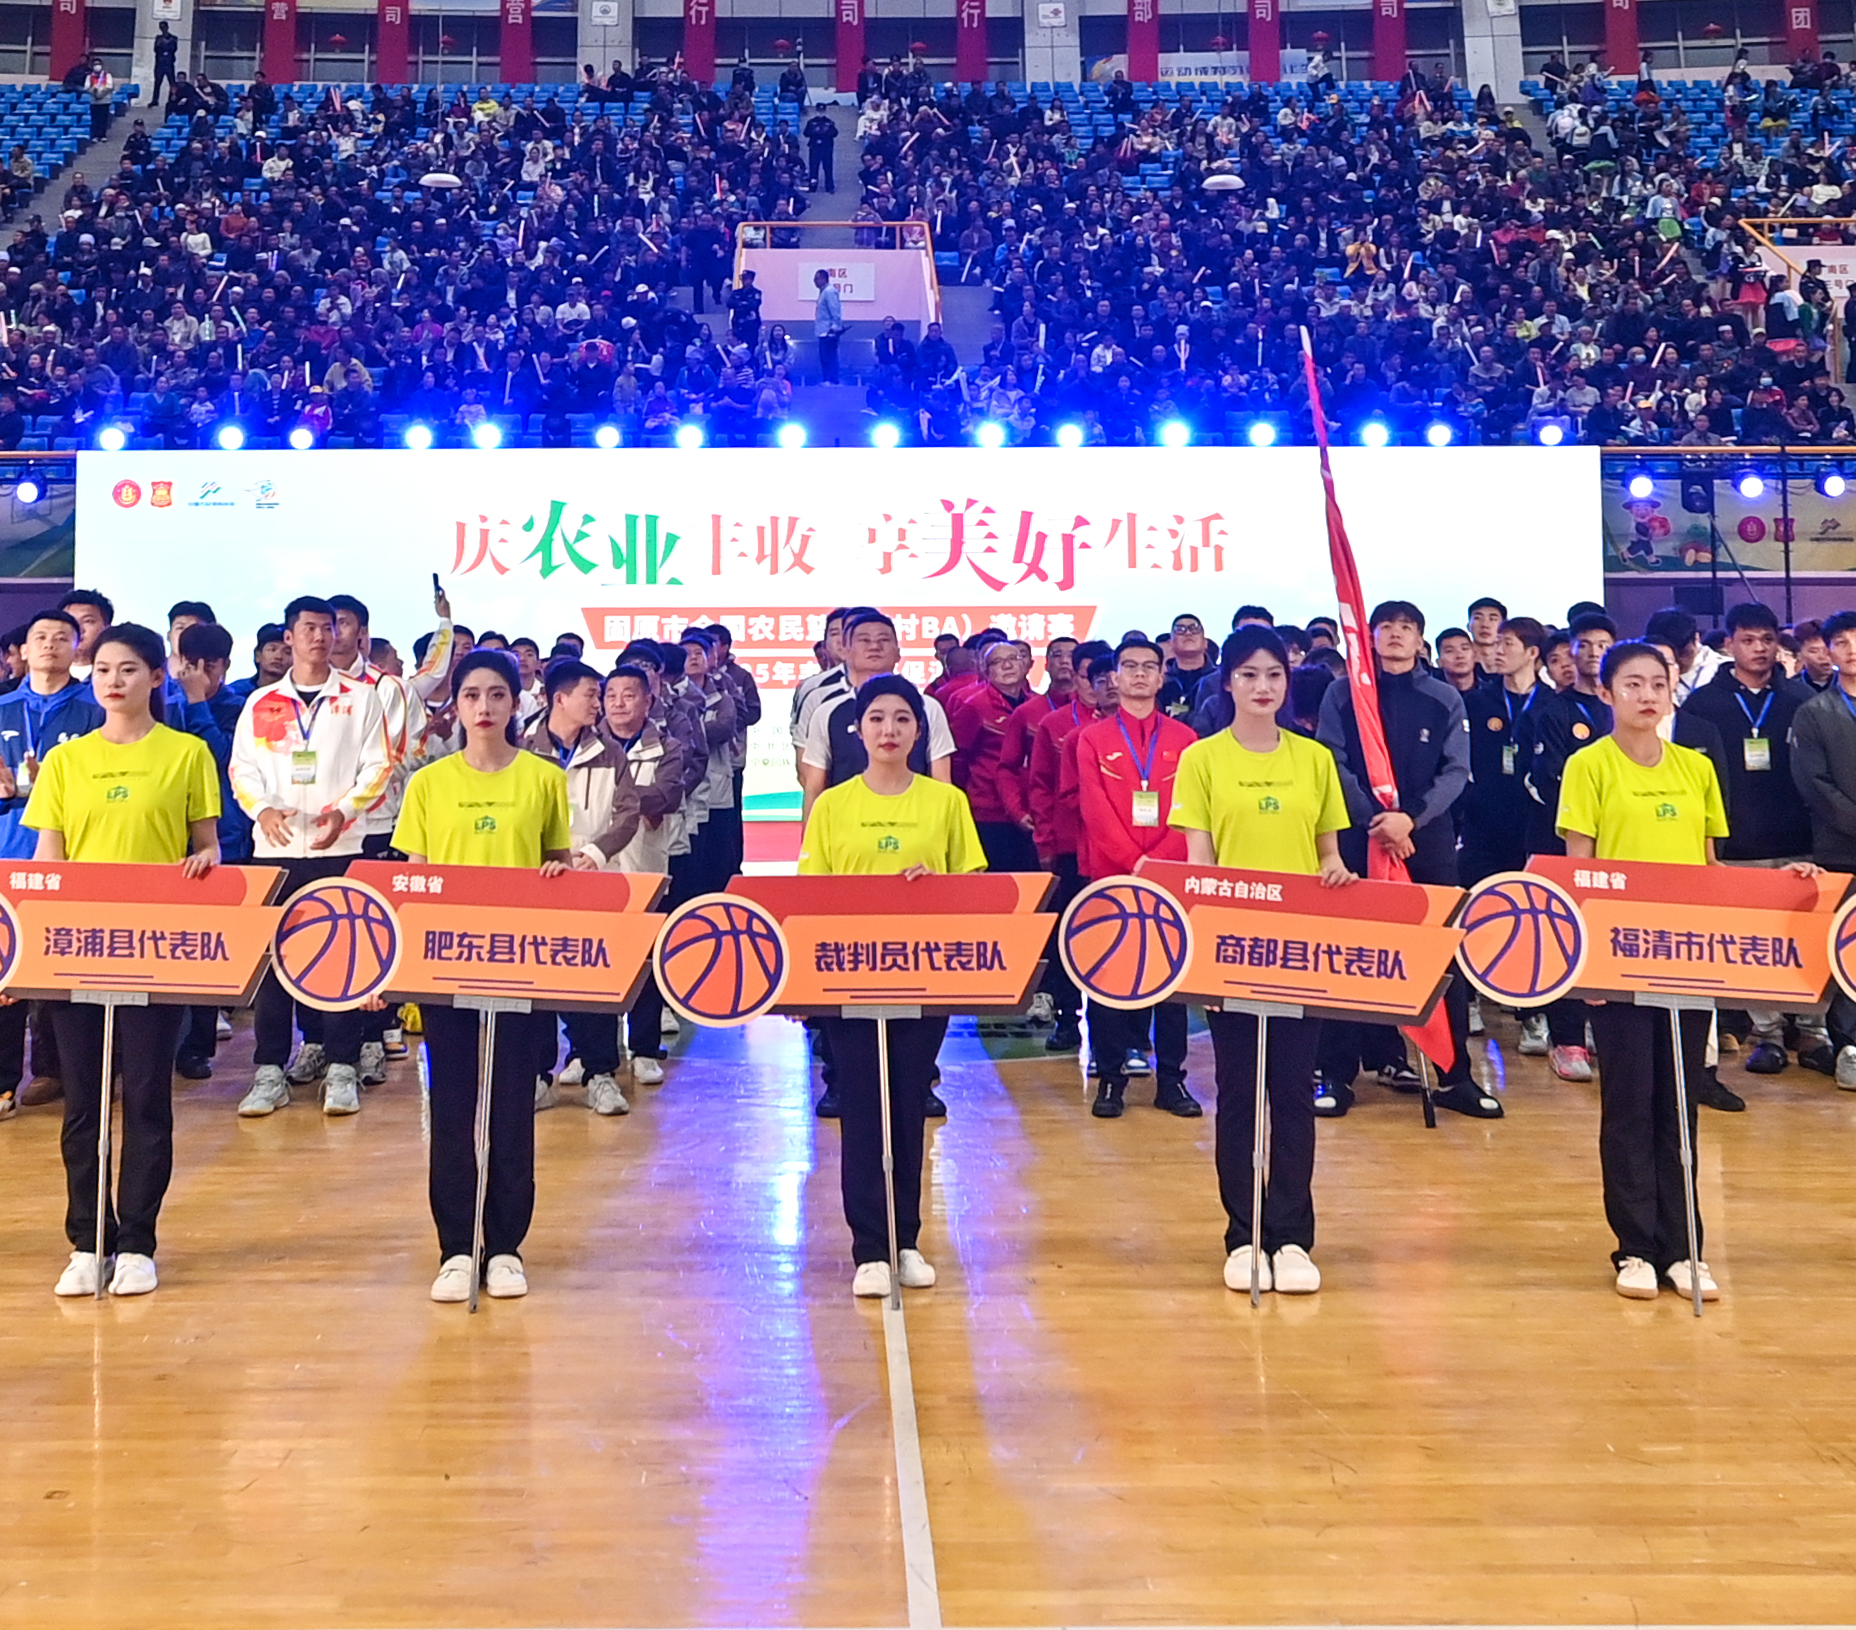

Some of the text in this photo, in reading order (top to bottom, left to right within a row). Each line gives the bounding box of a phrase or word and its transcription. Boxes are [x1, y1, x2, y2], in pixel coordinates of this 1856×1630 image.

[450, 496, 1230, 593] 庆农业丰收 享美好生活
[989, 612, 1076, 642] 邀请赛
[1257, 797, 1281, 812] LPS
[8, 870, 62, 892] 福建省
[391, 873, 444, 895] 安徽省
[1183, 876, 1284, 903] 内蒙古自治区
[1573, 868, 1628, 892] 福建省
[43, 926, 230, 964] 漳浦县代表队
[422, 930, 611, 969] 肥东县代表队
[813, 939, 1008, 973] 裁判员代表队
[1213, 934, 1409, 982] 商都县代表队
[1609, 926, 1805, 971] 福清市代表队
